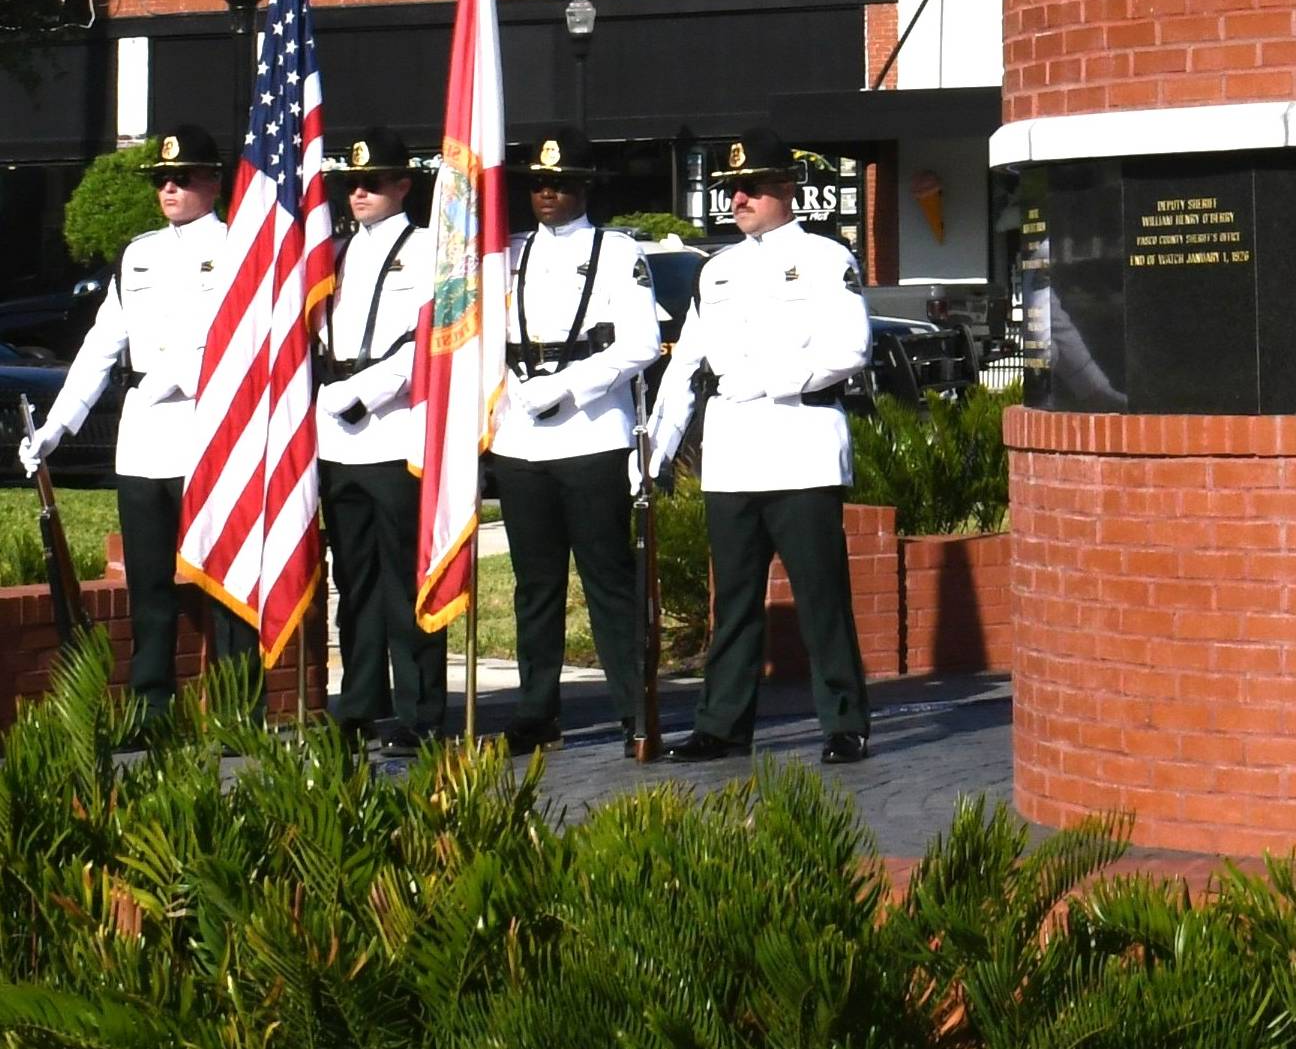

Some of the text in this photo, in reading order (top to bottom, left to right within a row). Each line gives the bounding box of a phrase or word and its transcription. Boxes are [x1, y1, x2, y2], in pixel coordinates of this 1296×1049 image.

[1157, 198, 1217, 211] DEPUTY SHERIFF
[1141, 215, 1173, 227] WILLIAM
[1136, 235, 1157, 246] PASCO
[1159, 234, 1184, 245] COUNTY
[1219, 231, 1240, 242] OFFICE
[1130, 255, 1145, 266] END
[1146, 254, 1155, 265] OF
[1158, 253, 1184, 265] WATCH
[1186, 251, 1220, 263] JANUARY
